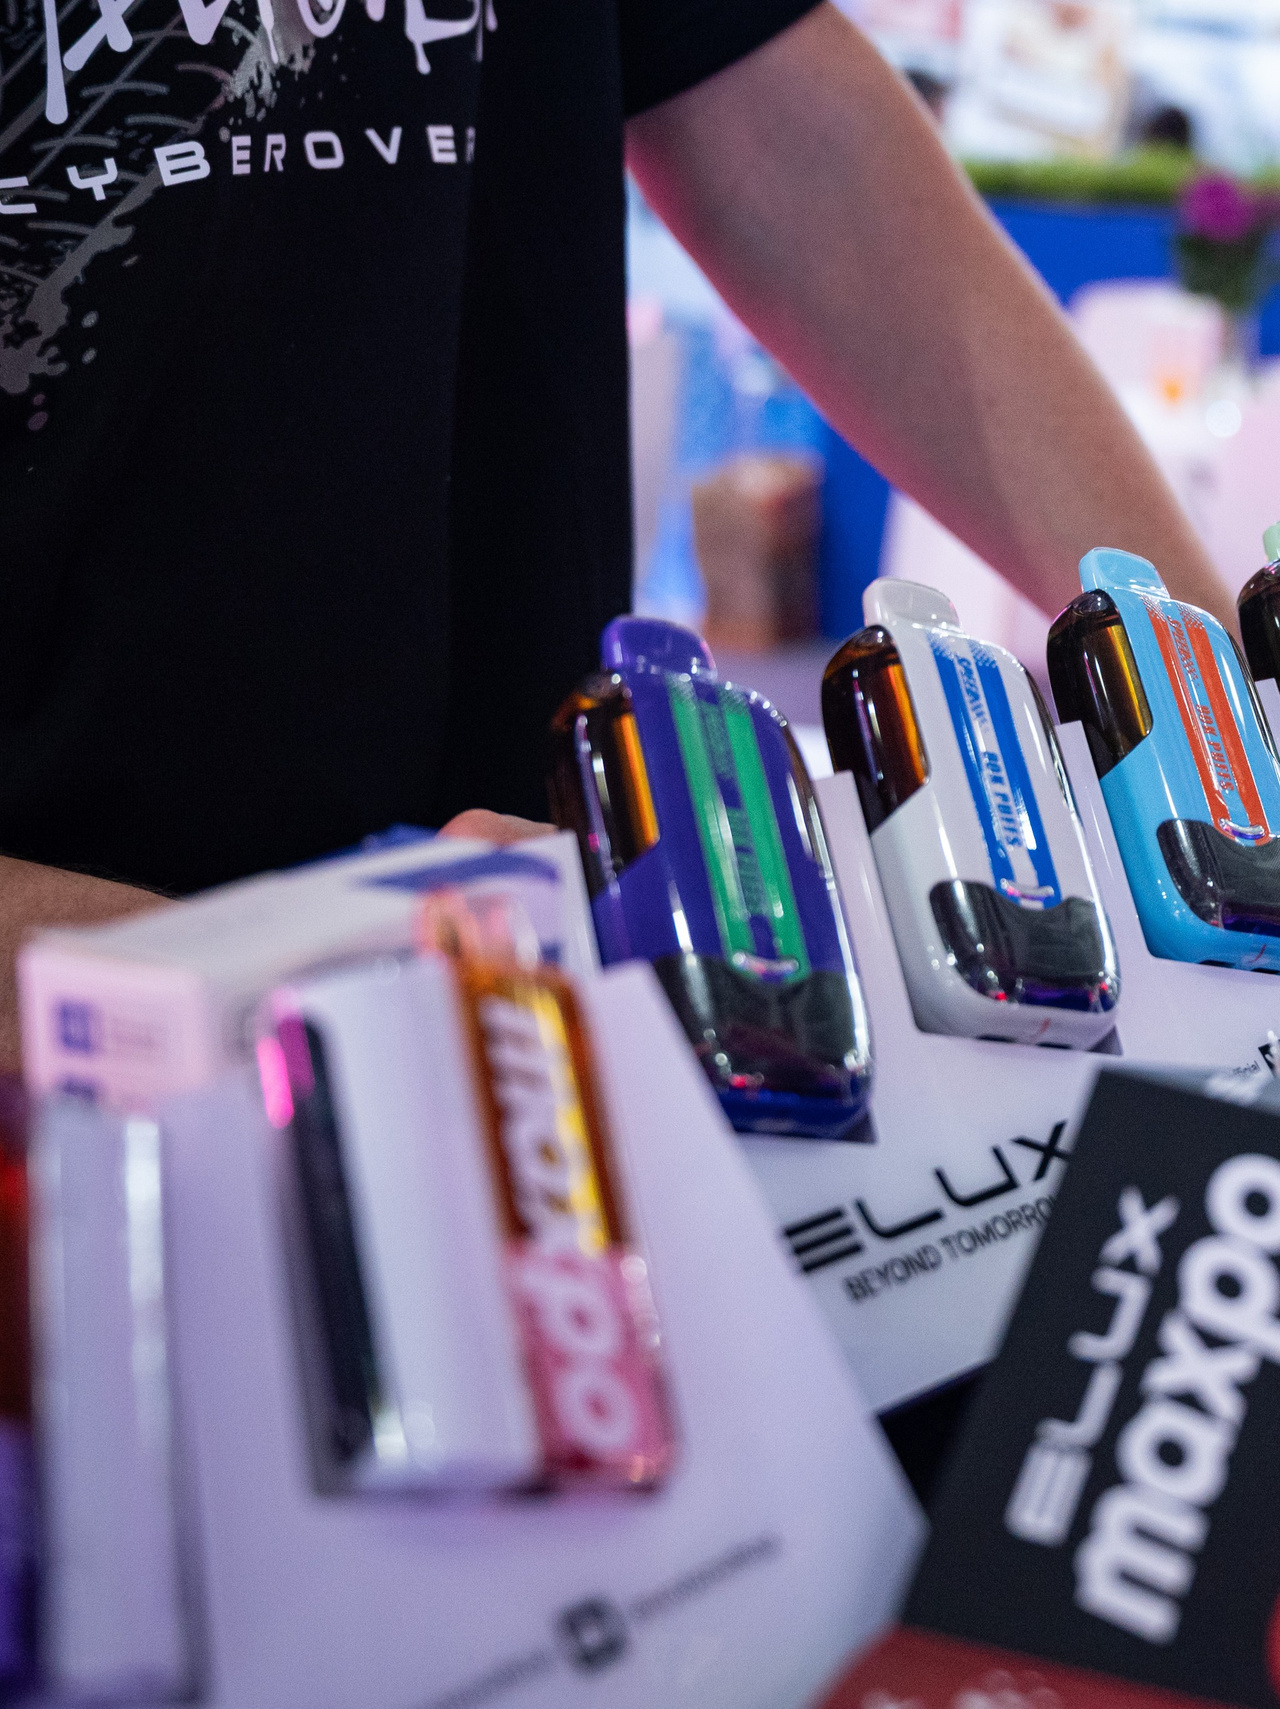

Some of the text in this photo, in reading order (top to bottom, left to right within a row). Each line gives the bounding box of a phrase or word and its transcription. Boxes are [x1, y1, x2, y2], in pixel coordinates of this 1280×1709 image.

[995, 790, 1023, 848] PUFFS
[1208, 740, 1235, 793] PUFFS
[783, 1119, 1071, 1274] ELUX
[844, 1193, 1058, 1302] BEYOND TOMORRO
[1004, 1185, 1182, 1549] ELUX
